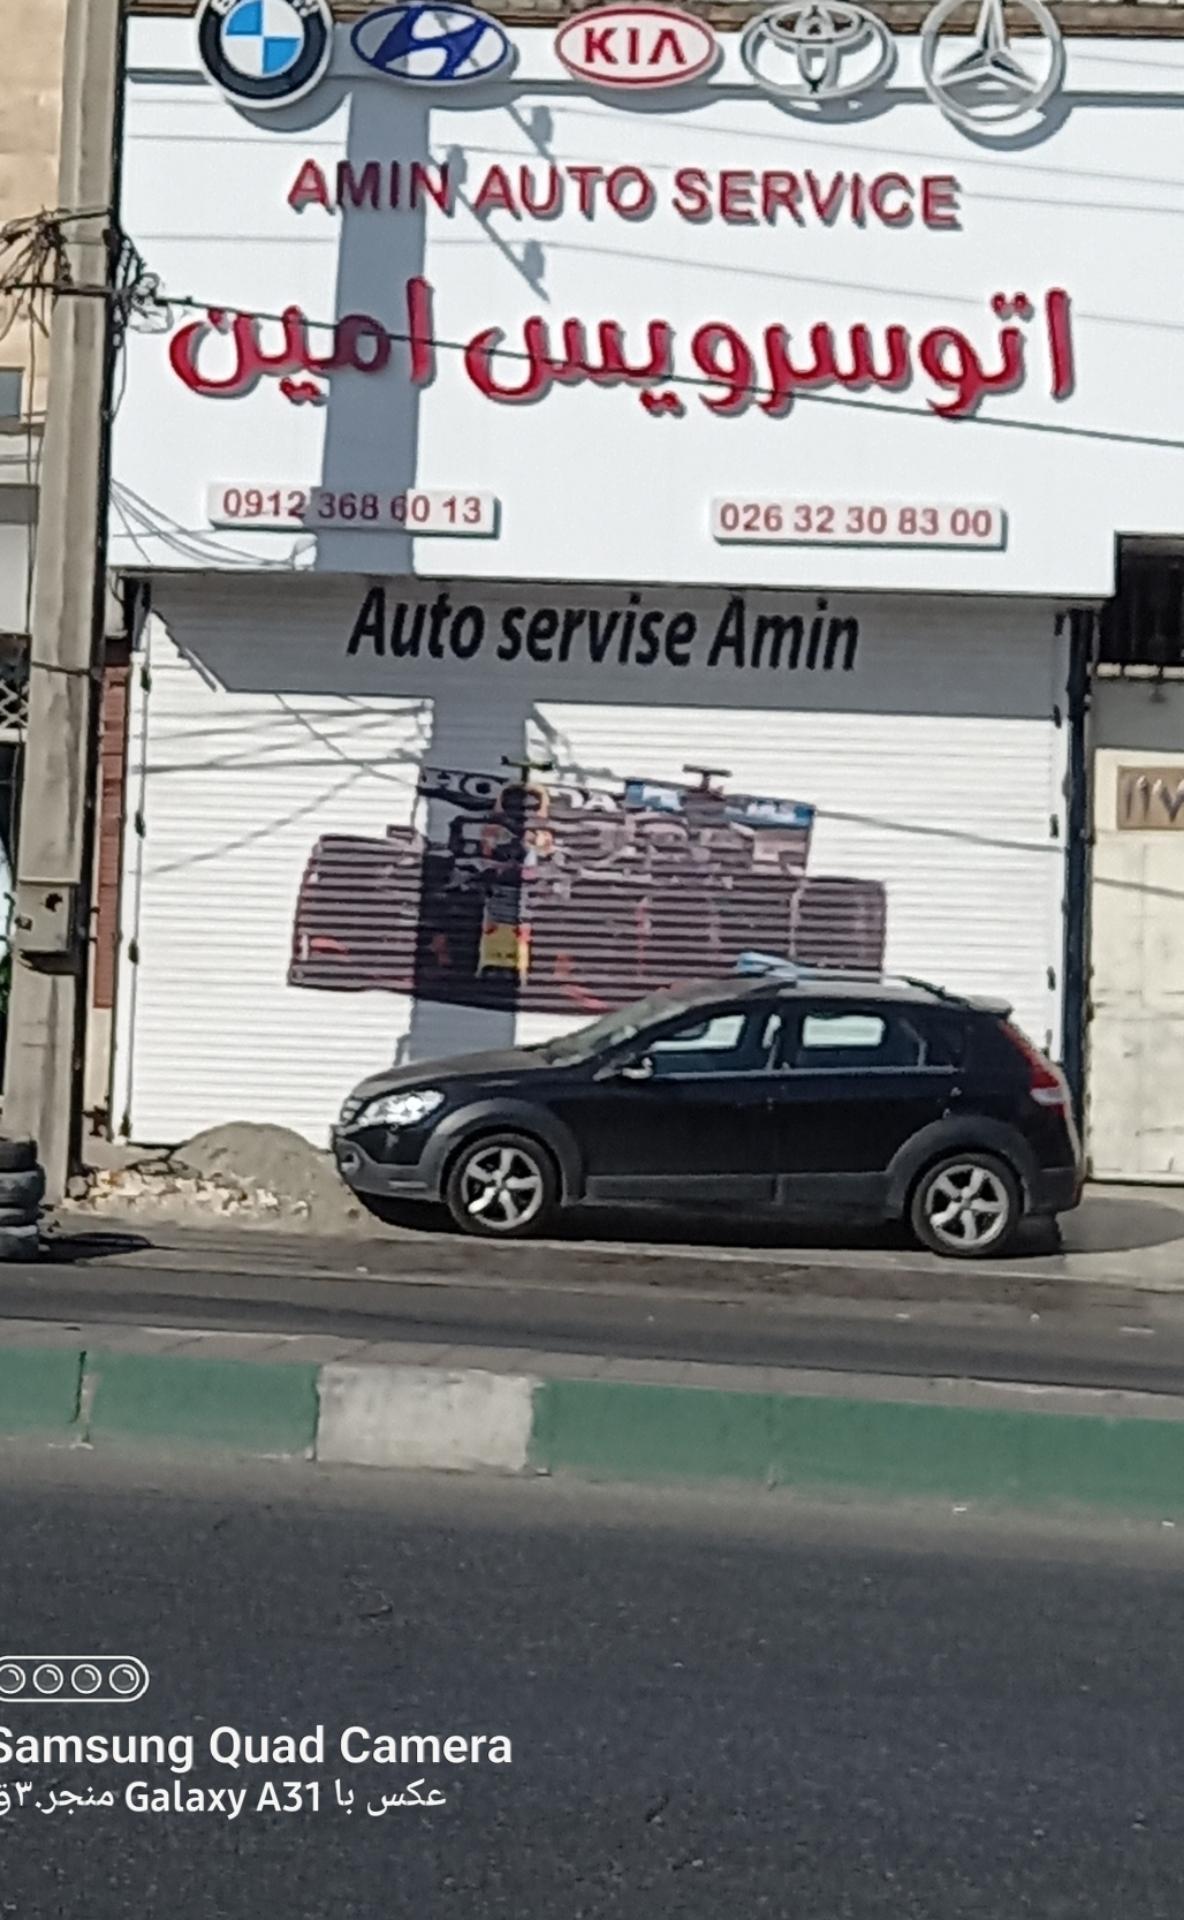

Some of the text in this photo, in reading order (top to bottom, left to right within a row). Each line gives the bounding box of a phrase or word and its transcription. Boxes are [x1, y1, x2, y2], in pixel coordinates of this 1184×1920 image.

[584, 26, 687, 66] KIA
[287, 158, 961, 230] AMIN AUTO SERVICE
[169, 277, 435, 405] امین
[222, 488, 482, 524] 0912 368 60 13
[720, 503, 992, 537] 026 32 30 83 00
[346, 586, 860, 671] Auto servise Amin
